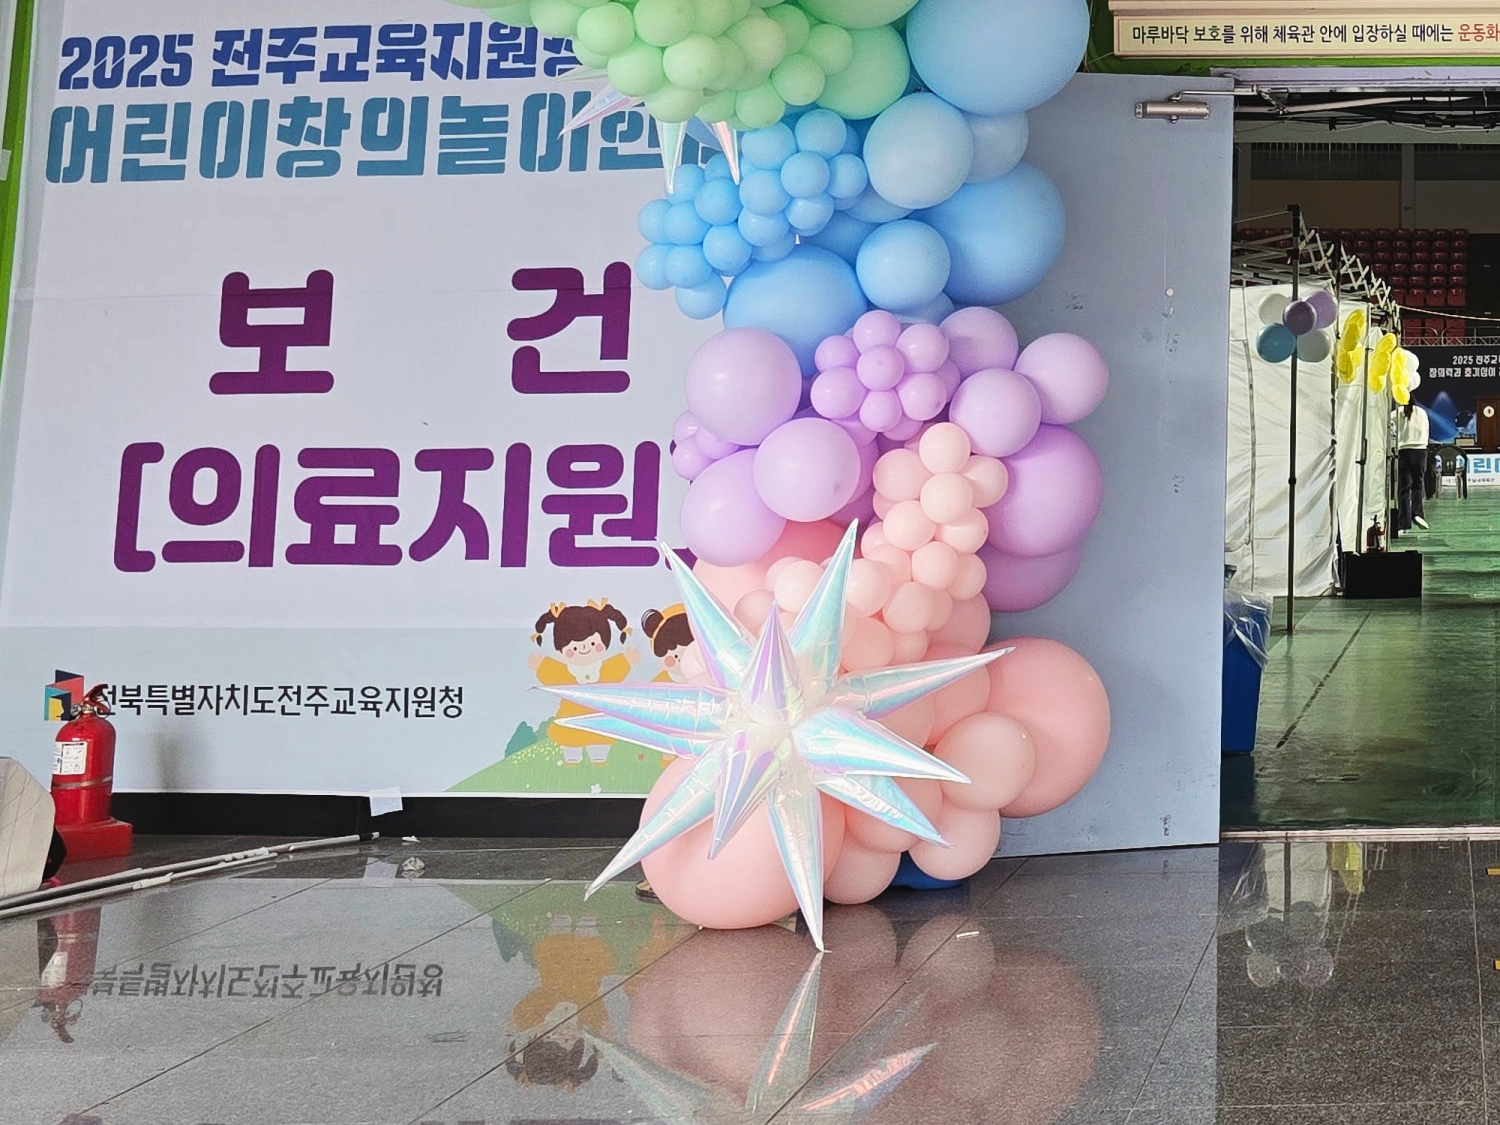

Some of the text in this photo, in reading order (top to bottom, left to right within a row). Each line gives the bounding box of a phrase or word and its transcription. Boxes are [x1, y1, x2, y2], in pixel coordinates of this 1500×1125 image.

[59, 33, 195, 91] 2025
[1132, 25, 1189, 45] 마루바닥
[1193, 24, 1236, 44] 보호를
[1240, 24, 1268, 44] 위해
[1273, 24, 1315, 44] 체육관
[1319, 24, 1347, 44] 안에
[1352, 23, 1407, 44] 입장하실
[1412, 23, 1454, 43] 때에는
[46, 91, 717, 183] 어린이창의놀이한
[209, 262, 632, 394] 보 건
[1452, 355, 1474, 365] 2025
[114, 441, 697, 573] [의료지원
